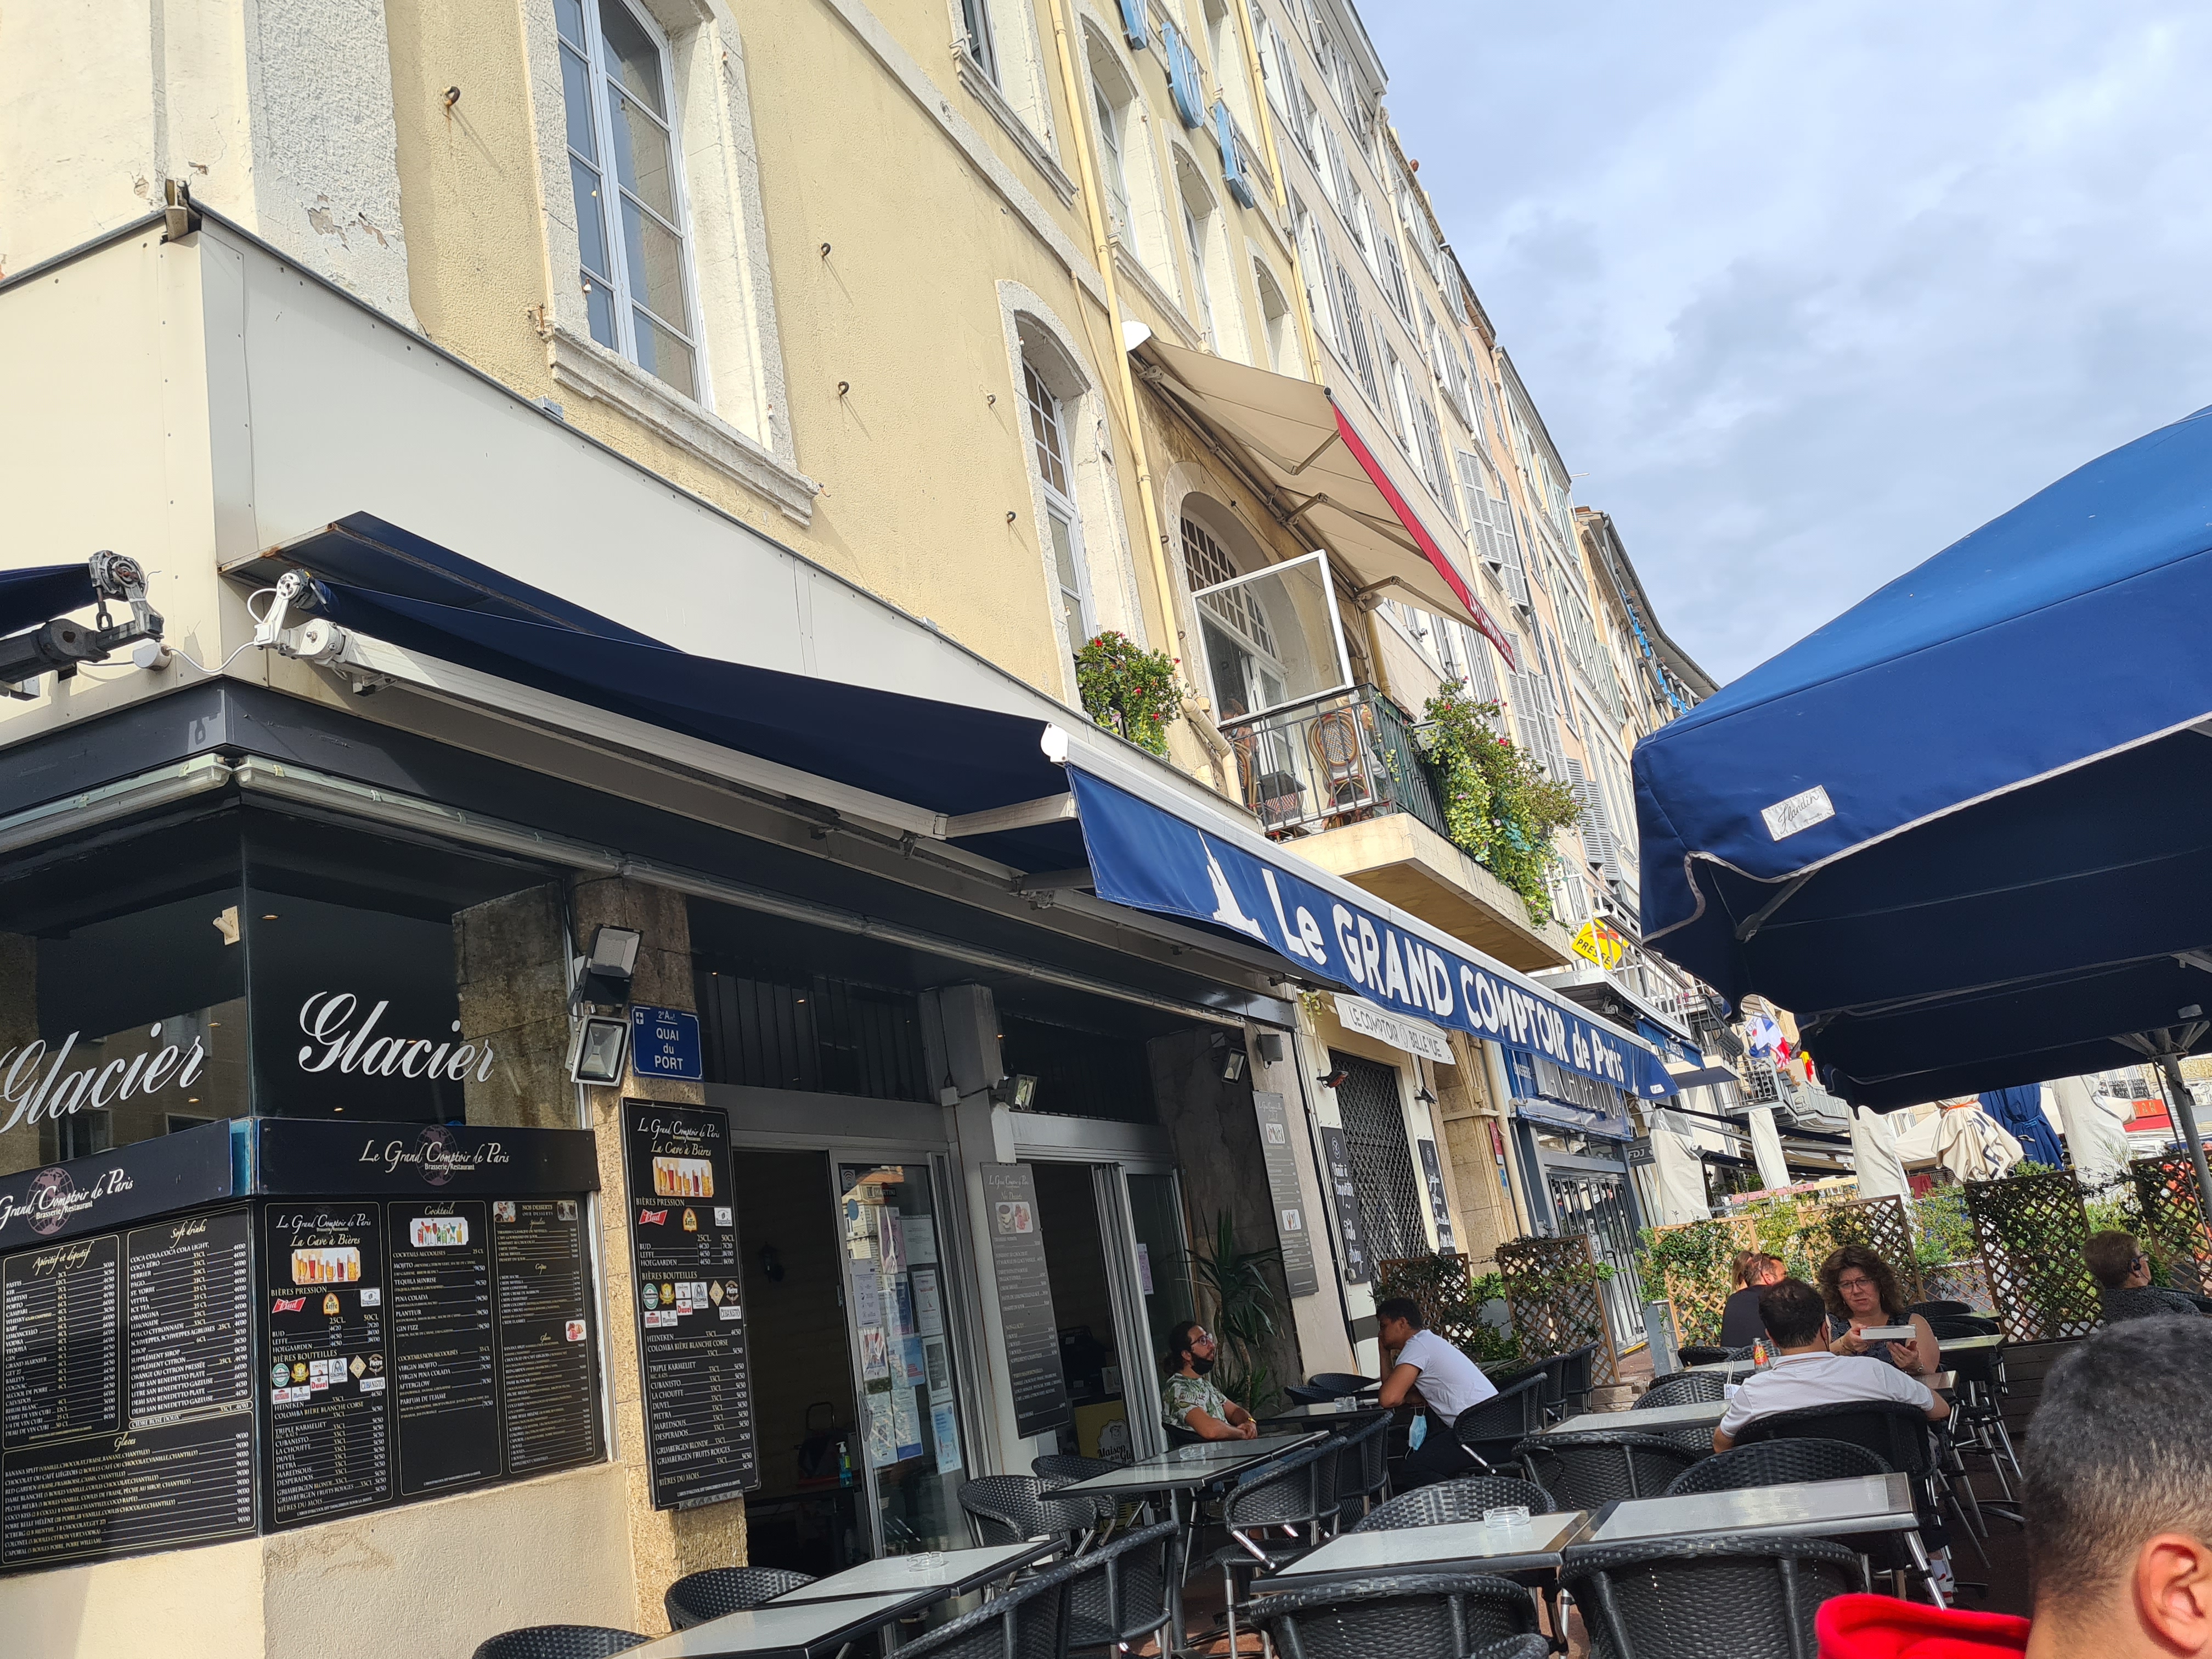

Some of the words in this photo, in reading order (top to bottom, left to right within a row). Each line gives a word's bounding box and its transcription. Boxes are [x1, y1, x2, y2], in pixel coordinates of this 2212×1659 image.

[1262, 868, 1327, 965] Le
[1333, 903, 1454, 1017] GRAND
[1460, 965, 1570, 1063] COMPTOIR
[1572, 1021, 1590, 1071] de
[1591, 1029, 1624, 1082] Paris
[656, 1028, 679, 1041] QUAI
[1348, 1006, 1362, 1027] LE
[1361, 1011, 1400, 1043] COMPTOIR
[1408, 1031, 1429, 1053] BELLE
[298, 991, 494, 1082] Glacier
[663, 1043, 674, 1054] du
[654, 1055, 683, 1070] PORT
[0, 1022, 204, 1133] Glacier
[637, 1118, 648, 1132] Le
[651, 1119, 674, 1139] Grand
[674, 1121, 698, 1143] Comptoir
[699, 1125, 706, 1137] de
[707, 1124, 720, 1138] Paris
[651, 1141, 663, 1153] La
[665, 1142, 682, 1154] Cave
[684, 1144, 690, 1155] à
[692, 1143, 712, 1156] Bières
[1628, 1148, 1644, 1159] FDJ
[359, 1139, 380, 1163] Le
[385, 1141, 428, 1173] Grand
[426, 1142, 471, 1175] Comptoir
[473, 1144, 485, 1163] de
[487, 1143, 510, 1163] Paris
[0, 1190, 41, 1231] Grand
[38, 1186, 89, 1220] Comptoir
[91, 1174, 106, 1200] de
[107, 1169, 133, 1194] Paris
[636, 1197, 656, 1205] BIÈRES
[36, 1209, 61, 1220] Brasserie
[64, 1200, 93, 1214] Restaurant
[425, 1202, 455, 1215] Cocktails
[276, 1215, 289, 1228] Le
[292, 1215, 318, 1234] Grand
[318, 1214, 346, 1234] Comptoir
[347, 1214, 355, 1227] de
[357, 1214, 371, 1226] Paris
[170, 1221, 188, 1249] Soft
[187, 1218, 207, 1235] drinks
[290, 1235, 304, 1246] La
[307, 1235, 328, 1245] Cave
[329, 1235, 335, 1244] à
[338, 1234, 360, 1245] Bières
[131, 1271, 151, 1280] PERRIER
[642, 1272, 662, 1280] BIÈRES
[271, 1287, 294, 1296] BIÈRES
[6, 1294, 27, 1303] MARTINI
[131, 1311, 159, 1322] ORANGINA
[131, 1319, 159, 1330] LIMONADE
[647, 1334, 674, 1342] HEINEKEN
[273, 1344, 312, 1353] HOEGAARDEN
[165, 1357, 186, 1366] CITRON
[273, 1354, 296, 1363] BIÈRES
[298, 1350, 337, 1359] BOUTEILLES
[146, 1379, 156, 1387] SAN
[158, 1373, 189, 1384] BENEDETTO
[190, 1370, 205, 1380] PLATE
[651, 1380, 681, 1389] CUBANISTO
[659, 1390, 684, 1399] CHOUFFE
[274, 1410, 303, 1419] COLOMBA
[321, 1403, 345, 1413] BLANCHE
[345, 1401, 364, 1409] CORSE
[275, 1402, 304, 1411] HEINEKEN
[296, 1421, 326, 1431] KARMELIET
[656, 1430, 688, 1441] DESPERADOS
[114, 1432, 136, 1452] Glaces
[275, 1437, 309, 1447] CUBANISTO
[284, 1444, 311, 1453] CHOUFFE
[276, 1455, 295, 1463] DUVEL
[276, 1462, 296, 1470] PIETRA
[276, 1466, 312, 1479] MAREDSOUS
[277, 1475, 314, 1486] DESPERADOS
[277, 1483, 313, 1496] GRIMBERGEN
[277, 1492, 315, 1504] GRIMBERGEN
[317, 1488, 334, 1496] FRUITS
[335, 1484, 354, 1493] ROUGES
[278, 1503, 297, 1513] BIÈRES
[308, 1498, 323, 1507] MOIS
